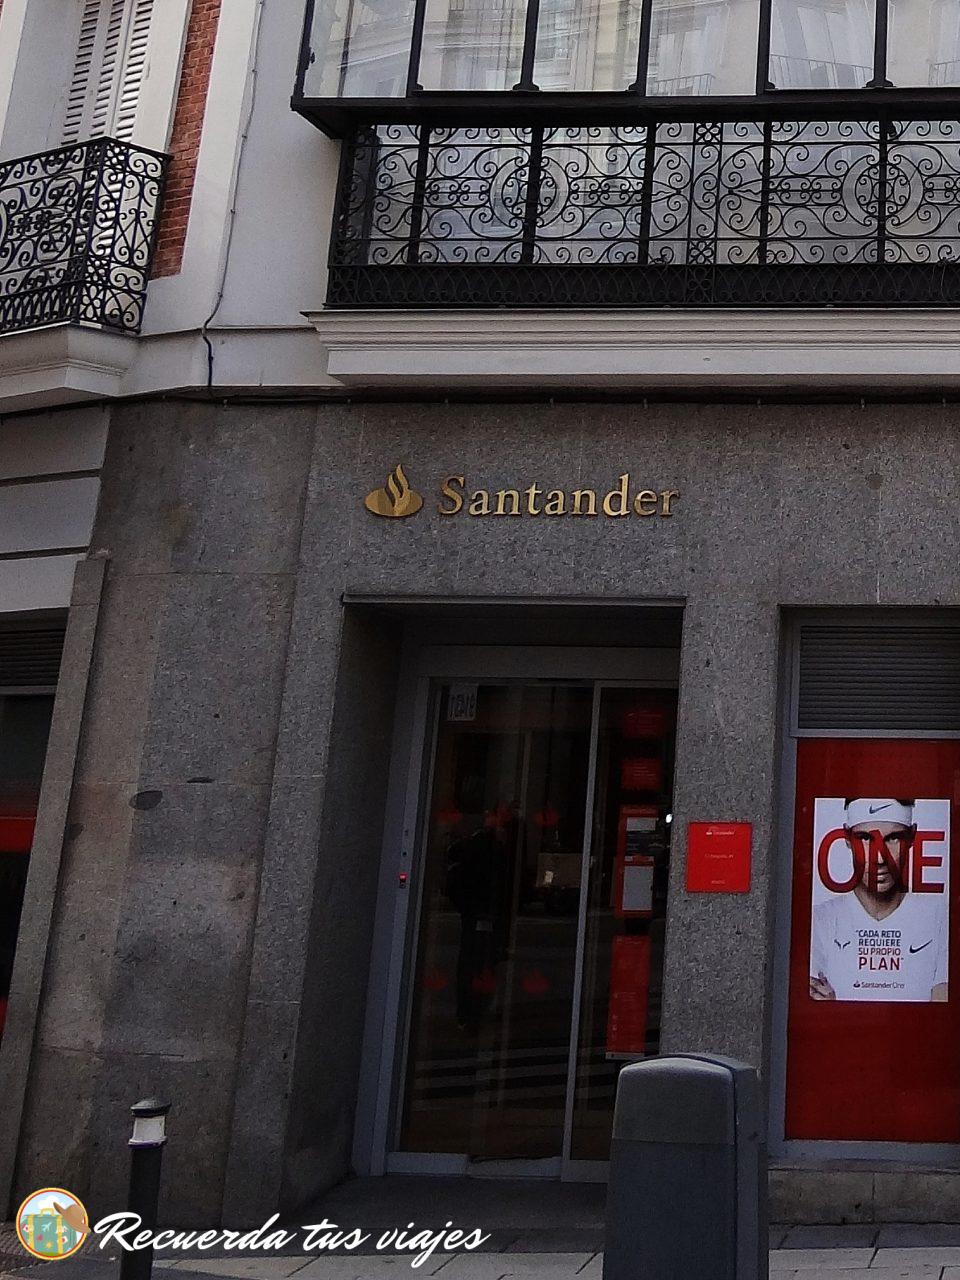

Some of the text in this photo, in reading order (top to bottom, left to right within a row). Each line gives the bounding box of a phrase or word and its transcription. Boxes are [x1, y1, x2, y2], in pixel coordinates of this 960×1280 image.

[437, 473, 680, 517] Santander
[817, 828, 945, 894] ONE
[881, 930, 902, 938] RETO
[858, 939, 901, 947] REQUIERE
[870, 948, 902, 956] PROPIO
